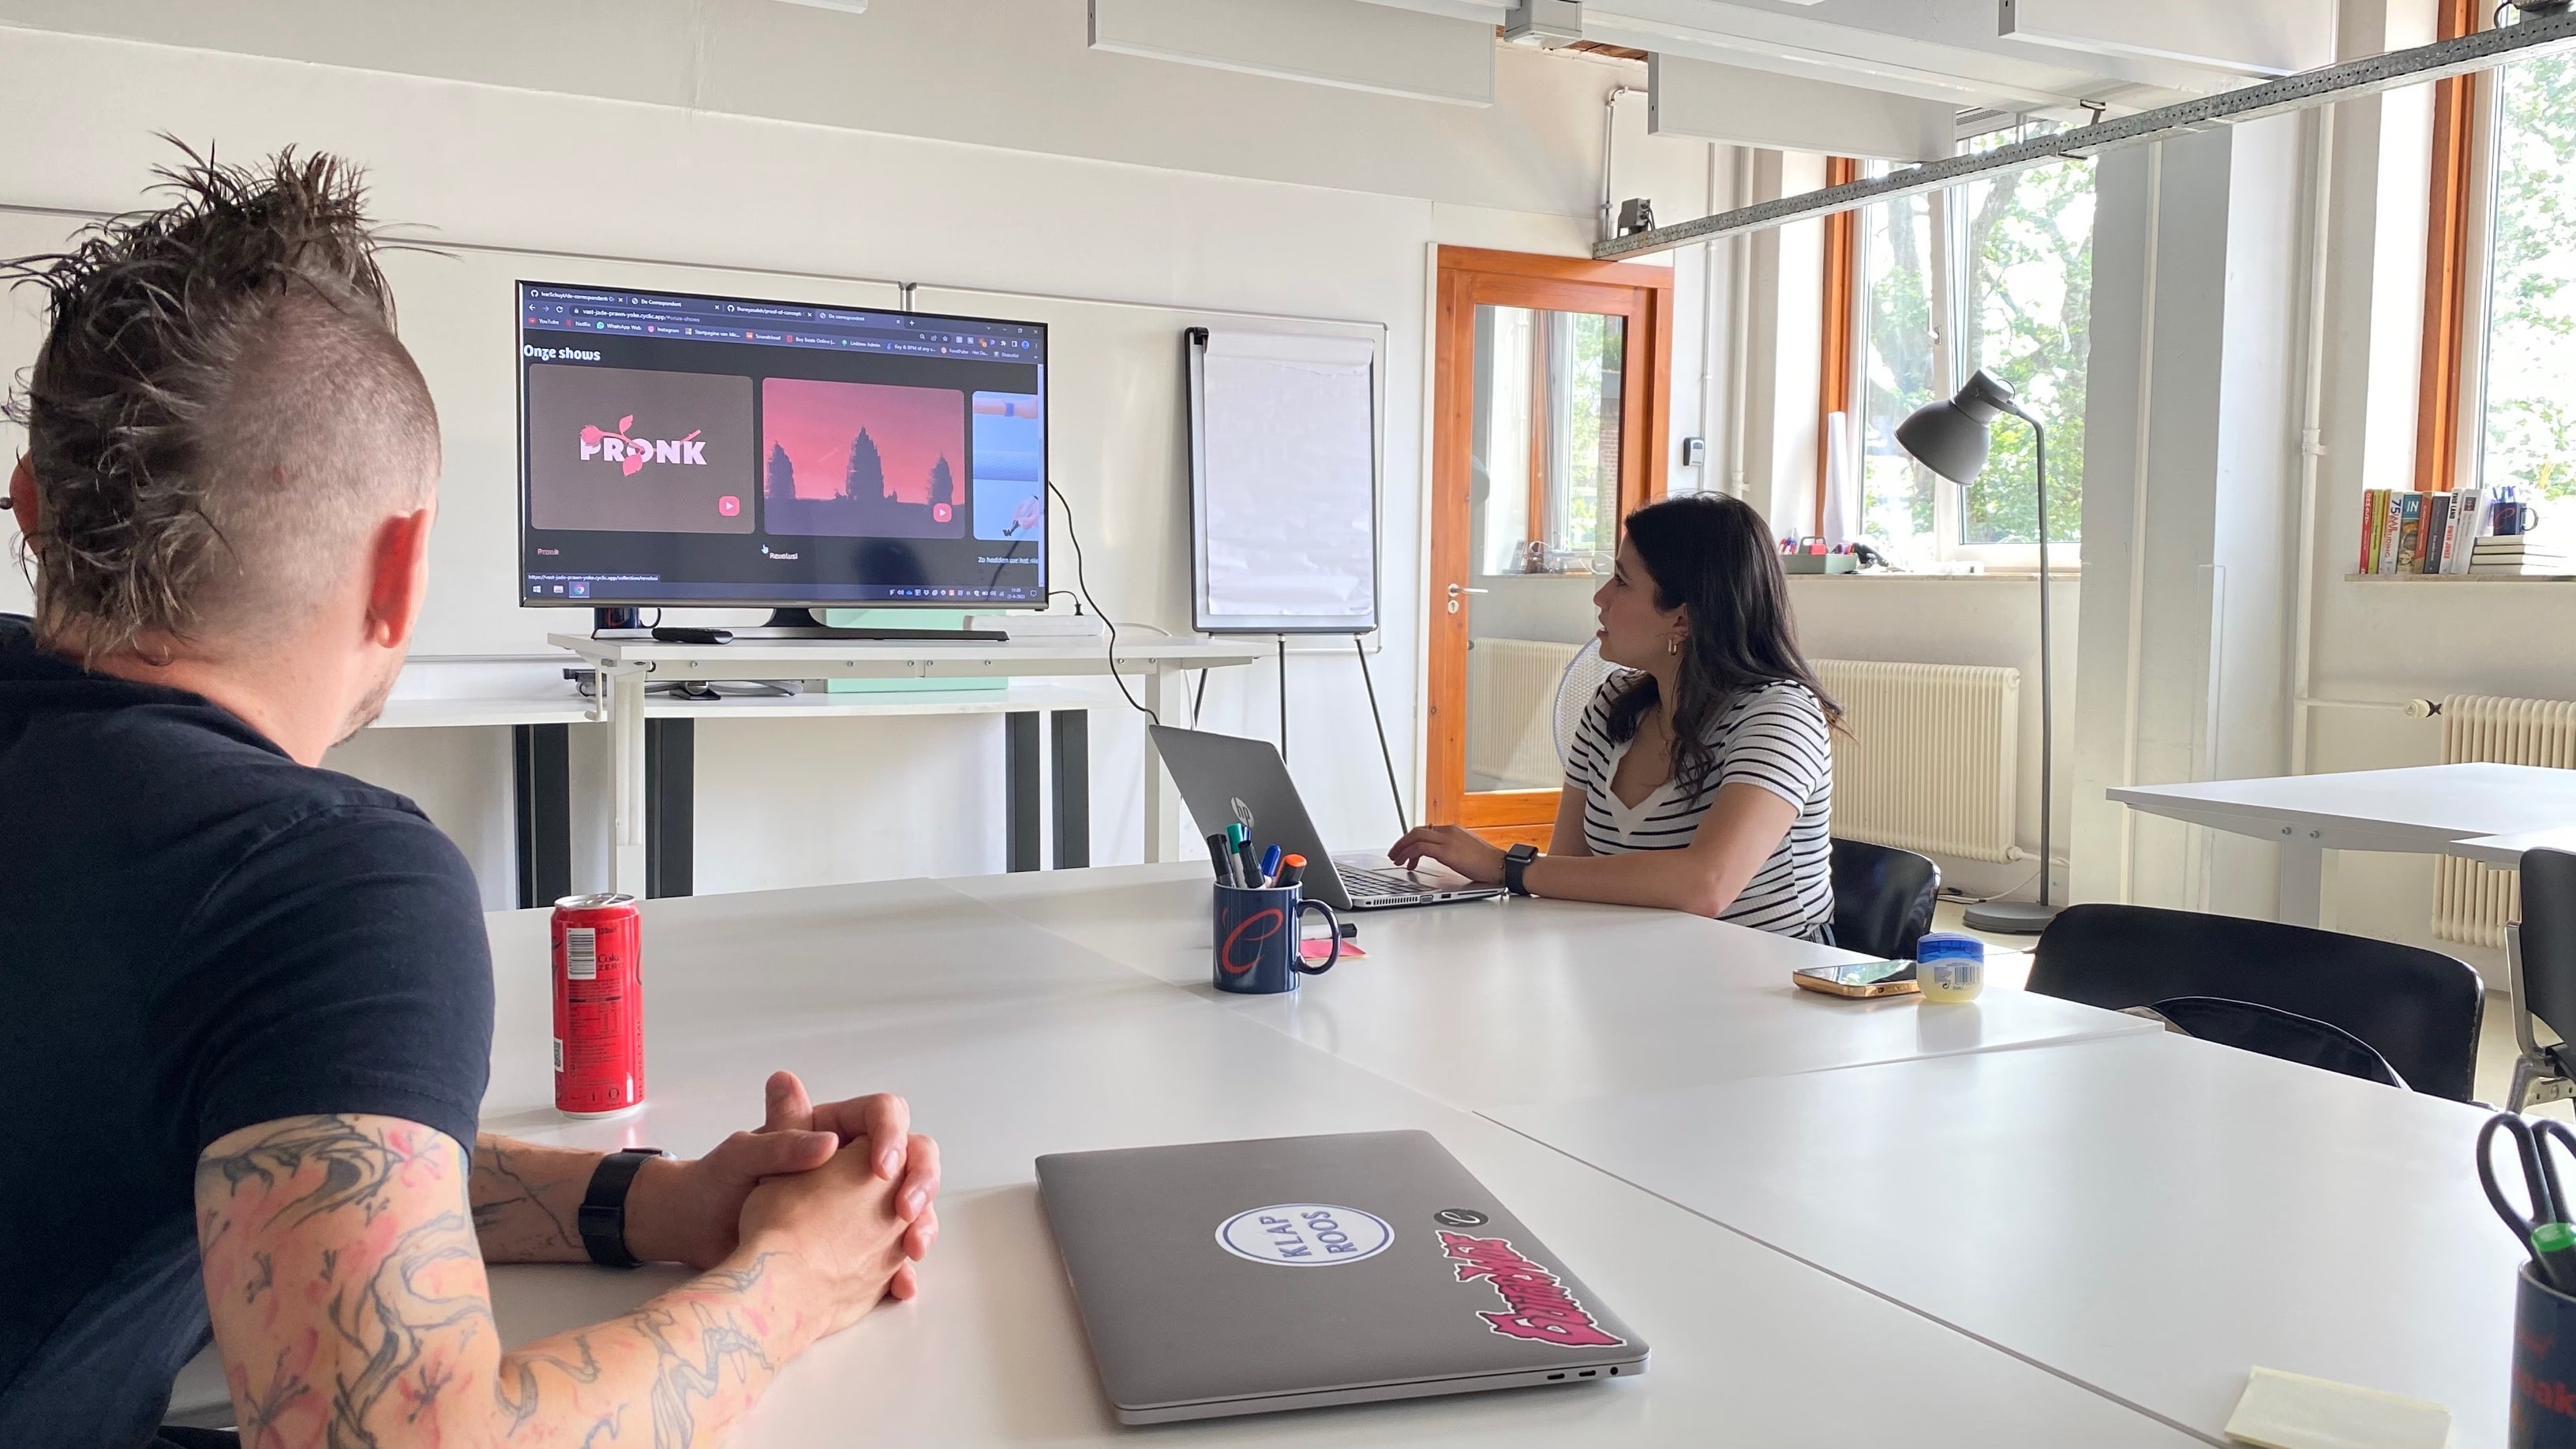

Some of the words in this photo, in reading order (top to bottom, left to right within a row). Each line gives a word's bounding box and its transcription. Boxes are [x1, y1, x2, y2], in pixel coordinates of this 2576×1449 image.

[657, 326, 680, 335] Instagram
[695, 328, 720, 337] Startpagina
[523, 344, 556, 361] Onze
[558, 347, 601, 361] shows
[580, 436, 708, 466] PRONK
[2391, 499, 2402, 514] 75
[1233, 796, 1251, 827] hp
[1259, 1215, 1312, 1258] KLAP
[1301, 1211, 1358, 1254] ROOS
